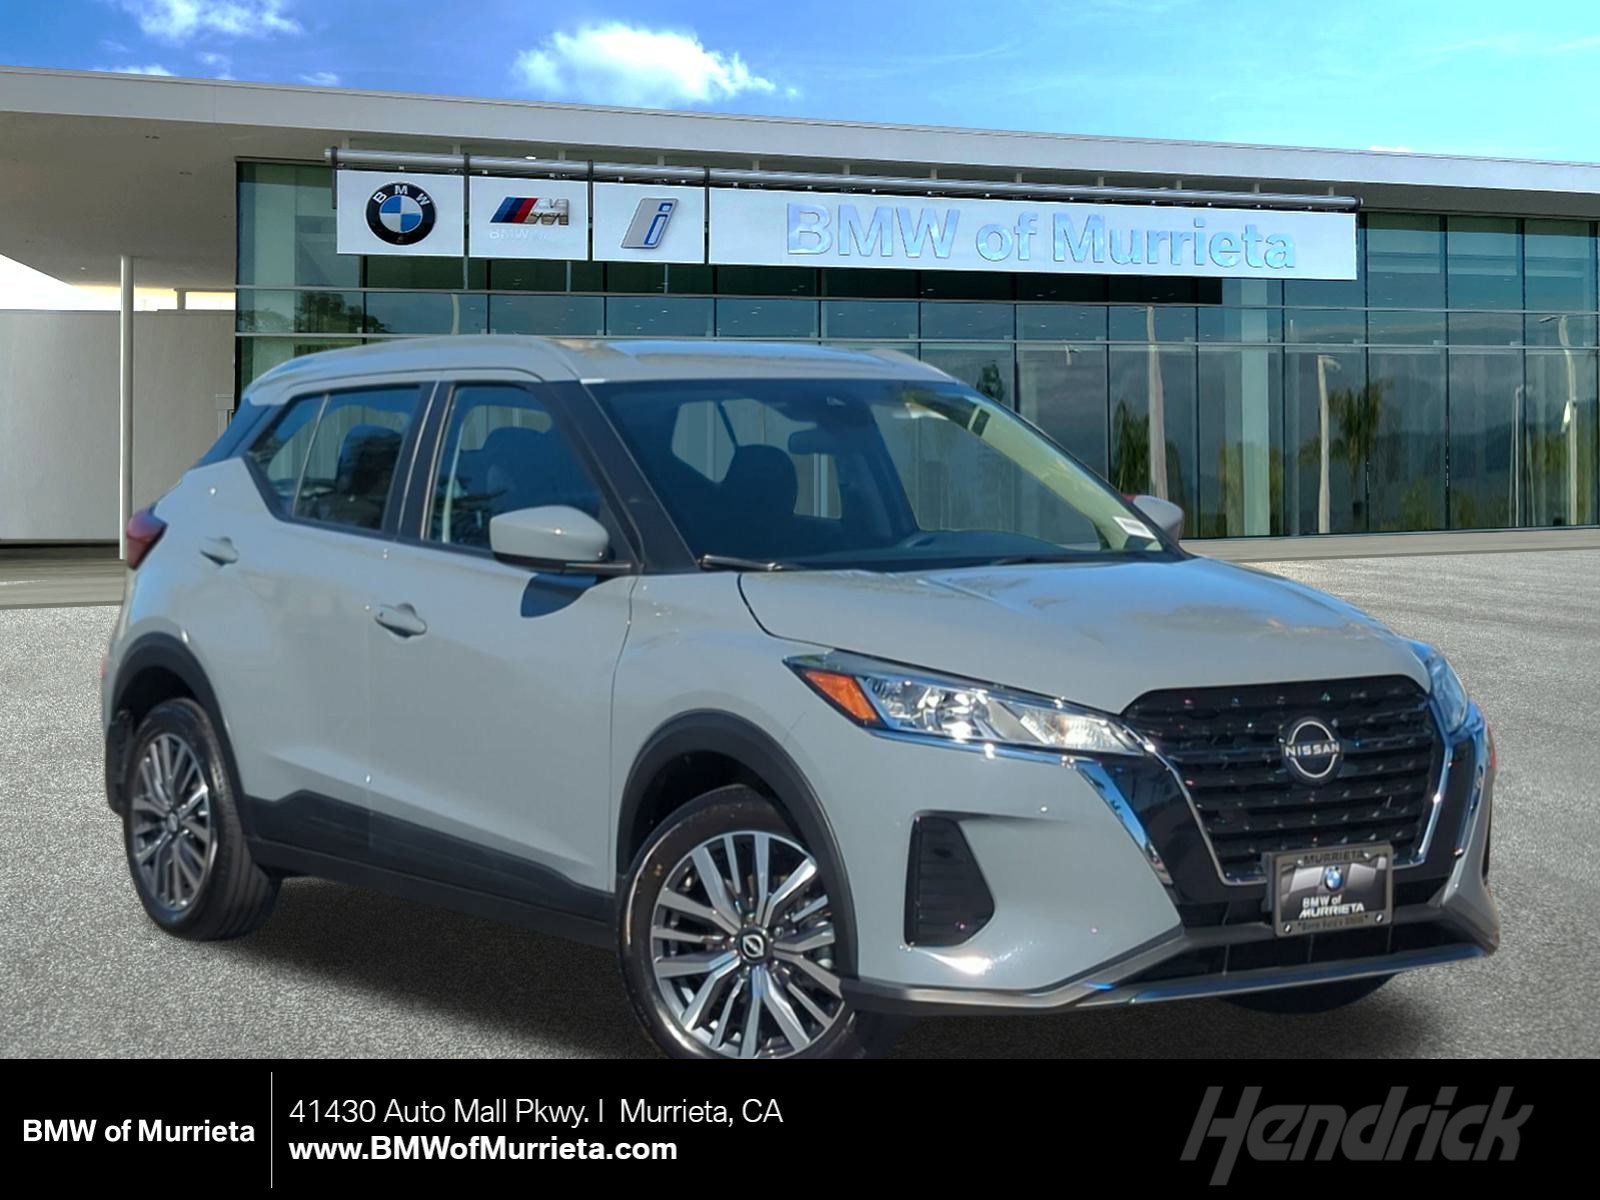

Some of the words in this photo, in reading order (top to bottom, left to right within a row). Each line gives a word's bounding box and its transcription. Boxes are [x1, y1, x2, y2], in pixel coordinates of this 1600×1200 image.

[373, 184, 431, 206] BMW
[786, 202, 961, 258] BMW
[976, 212, 1039, 262] of
[1052, 213, 1296, 270] Murrieta
[1285, 742, 1340, 757] NISSAN
[1303, 850, 1365, 864] MURRIETA
[1302, 894, 1330, 909] BMW
[1331, 893, 1343, 906] of
[1298, 901, 1365, 919] MURRIETA
